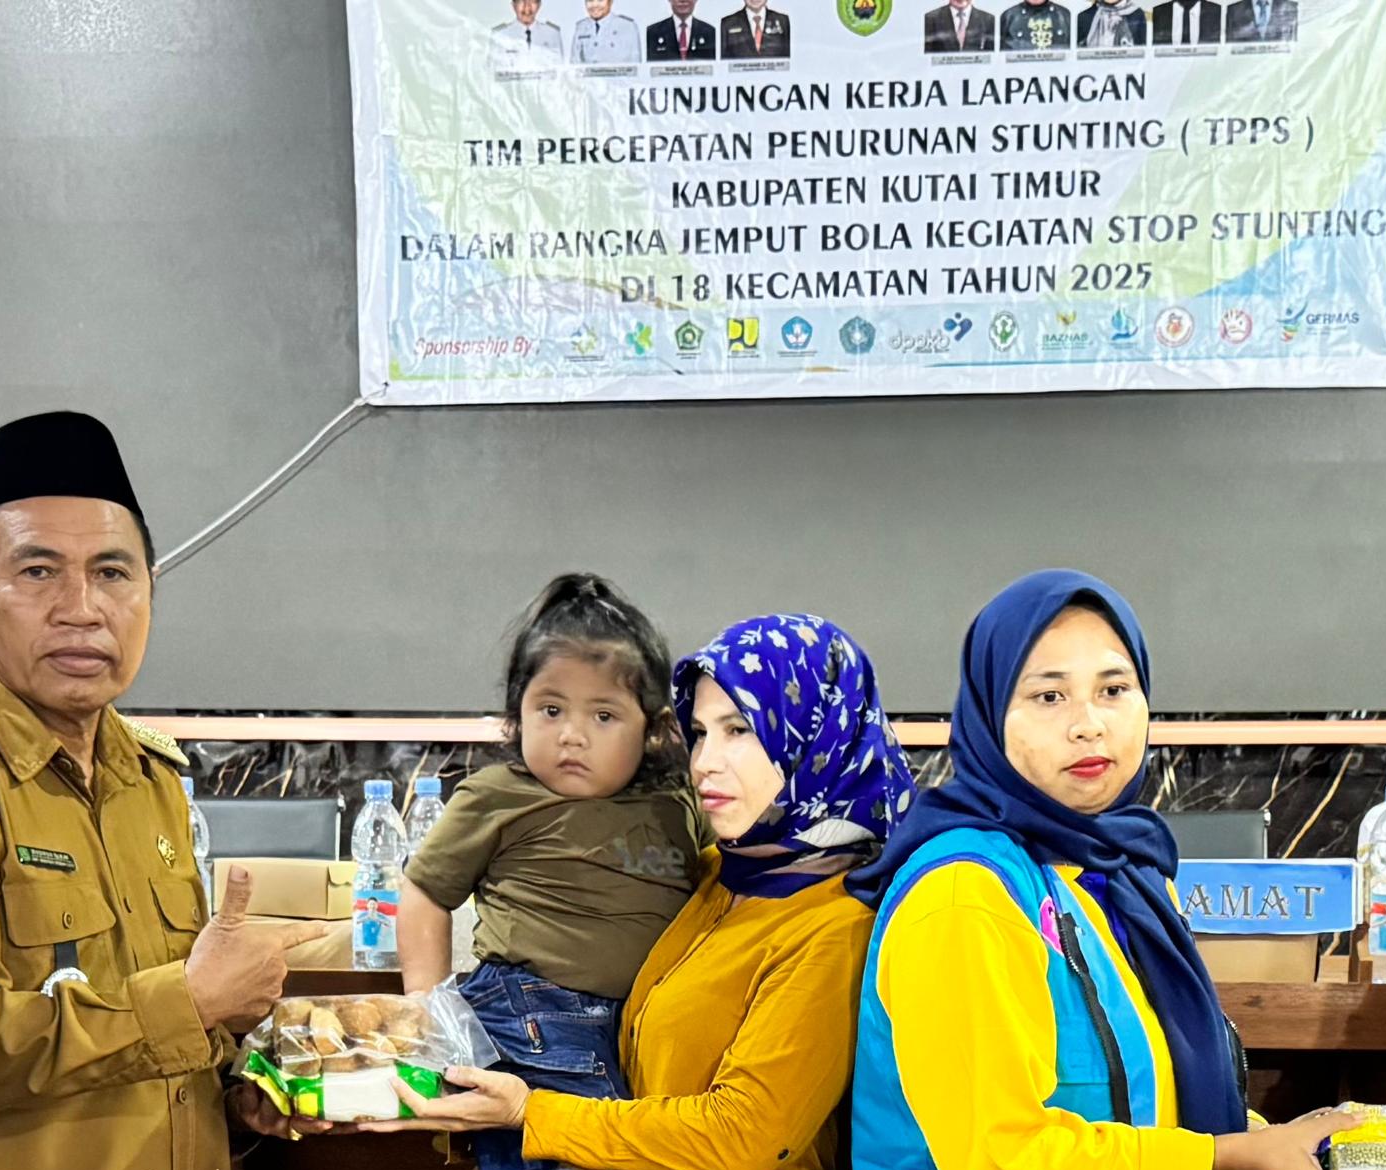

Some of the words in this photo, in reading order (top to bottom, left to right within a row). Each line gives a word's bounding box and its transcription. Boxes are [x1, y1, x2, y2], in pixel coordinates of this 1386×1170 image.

[628, 83, 830, 115] KUNJUNGAN
[845, 80, 948, 110] KERJA
[962, 73, 1146, 106] LAPANGAN
[463, 138, 522, 166] TIM
[537, 132, 752, 165] PERCEPATAN
[768, 125, 977, 158] PENURUNAN
[991, 119, 1165, 152] STUNTING
[1204, 116, 1291, 146] TPPS
[672, 176, 866, 208] KABUPATEN
[881, 173, 977, 203] KUTAI
[991, 169, 1101, 199] TIMUR
[400, 232, 514, 261] DALAM
[529, 229, 667, 258] RANGKA
[678, 225, 807, 256] JEMPUT
[821, 223, 912, 250] BOLA
[926, 217, 1093, 249] KEGIATAN
[1108, 213, 1198, 243] STOP
[1211, 208, 1386, 241] STUNTING
[621, 275, 656, 302] DI
[672, 273, 711, 301] 18
[726, 268, 928, 300] KECAMATAN
[941, 264, 1056, 295] TAHUN
[1071, 261, 1153, 291] 2025
[1042, 333, 1089, 343] BAZNAS
[1305, 312, 1360, 325] GERMAS
[414, 336, 509, 359] Sponsorship
[513, 335, 533, 358] By
[1184, 883, 1325, 920] AMAT
